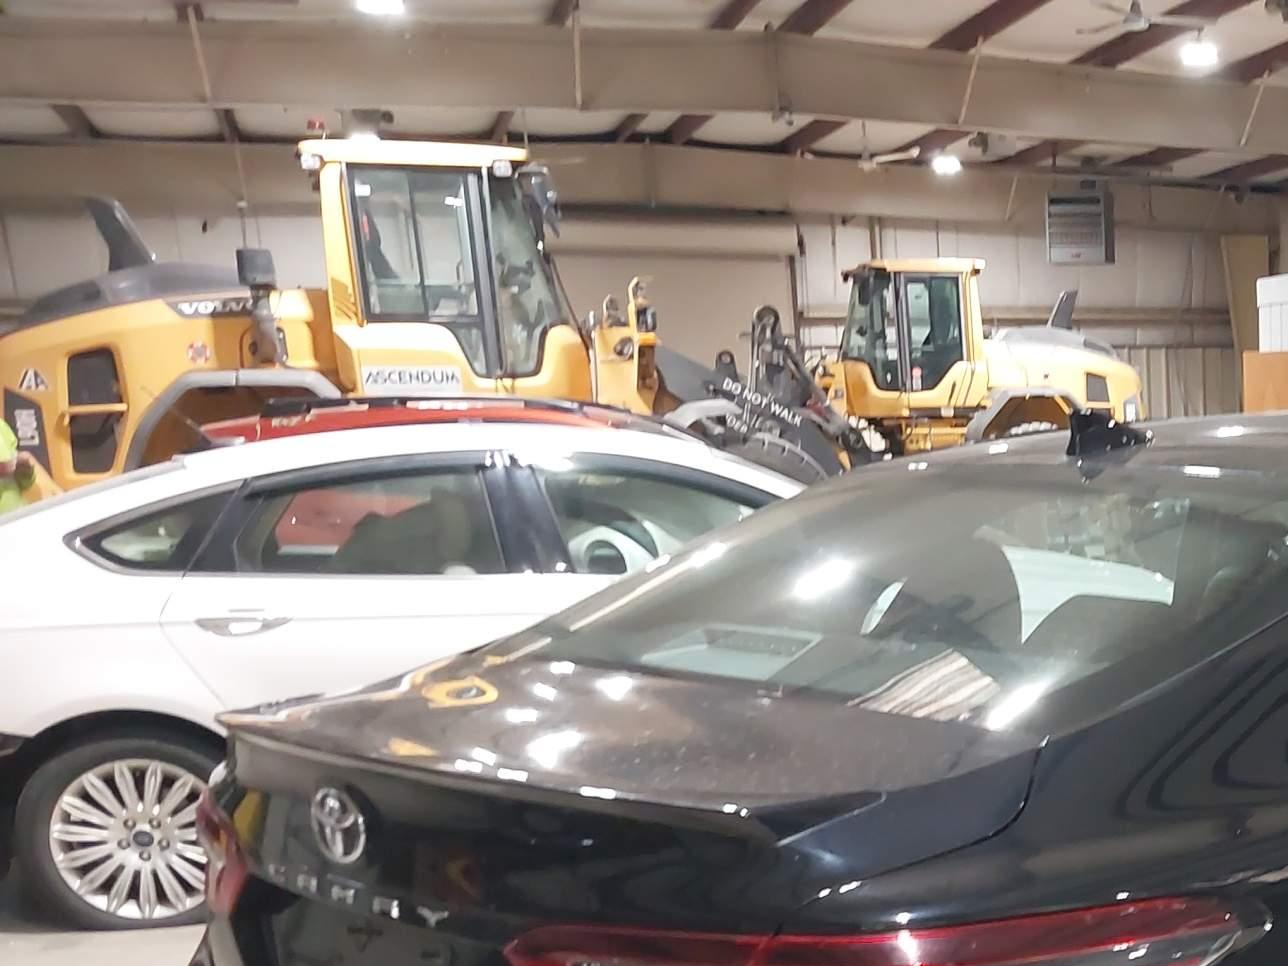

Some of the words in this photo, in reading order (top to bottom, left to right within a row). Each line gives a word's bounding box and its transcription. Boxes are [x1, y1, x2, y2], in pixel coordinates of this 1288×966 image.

[365, 369, 460, 384] ASCENDUM
[723, 377, 742, 395] DO
[743, 387, 769, 408] NOT
[770, 399, 802, 427] WALK
[268, 864, 449, 927] CAMRY
